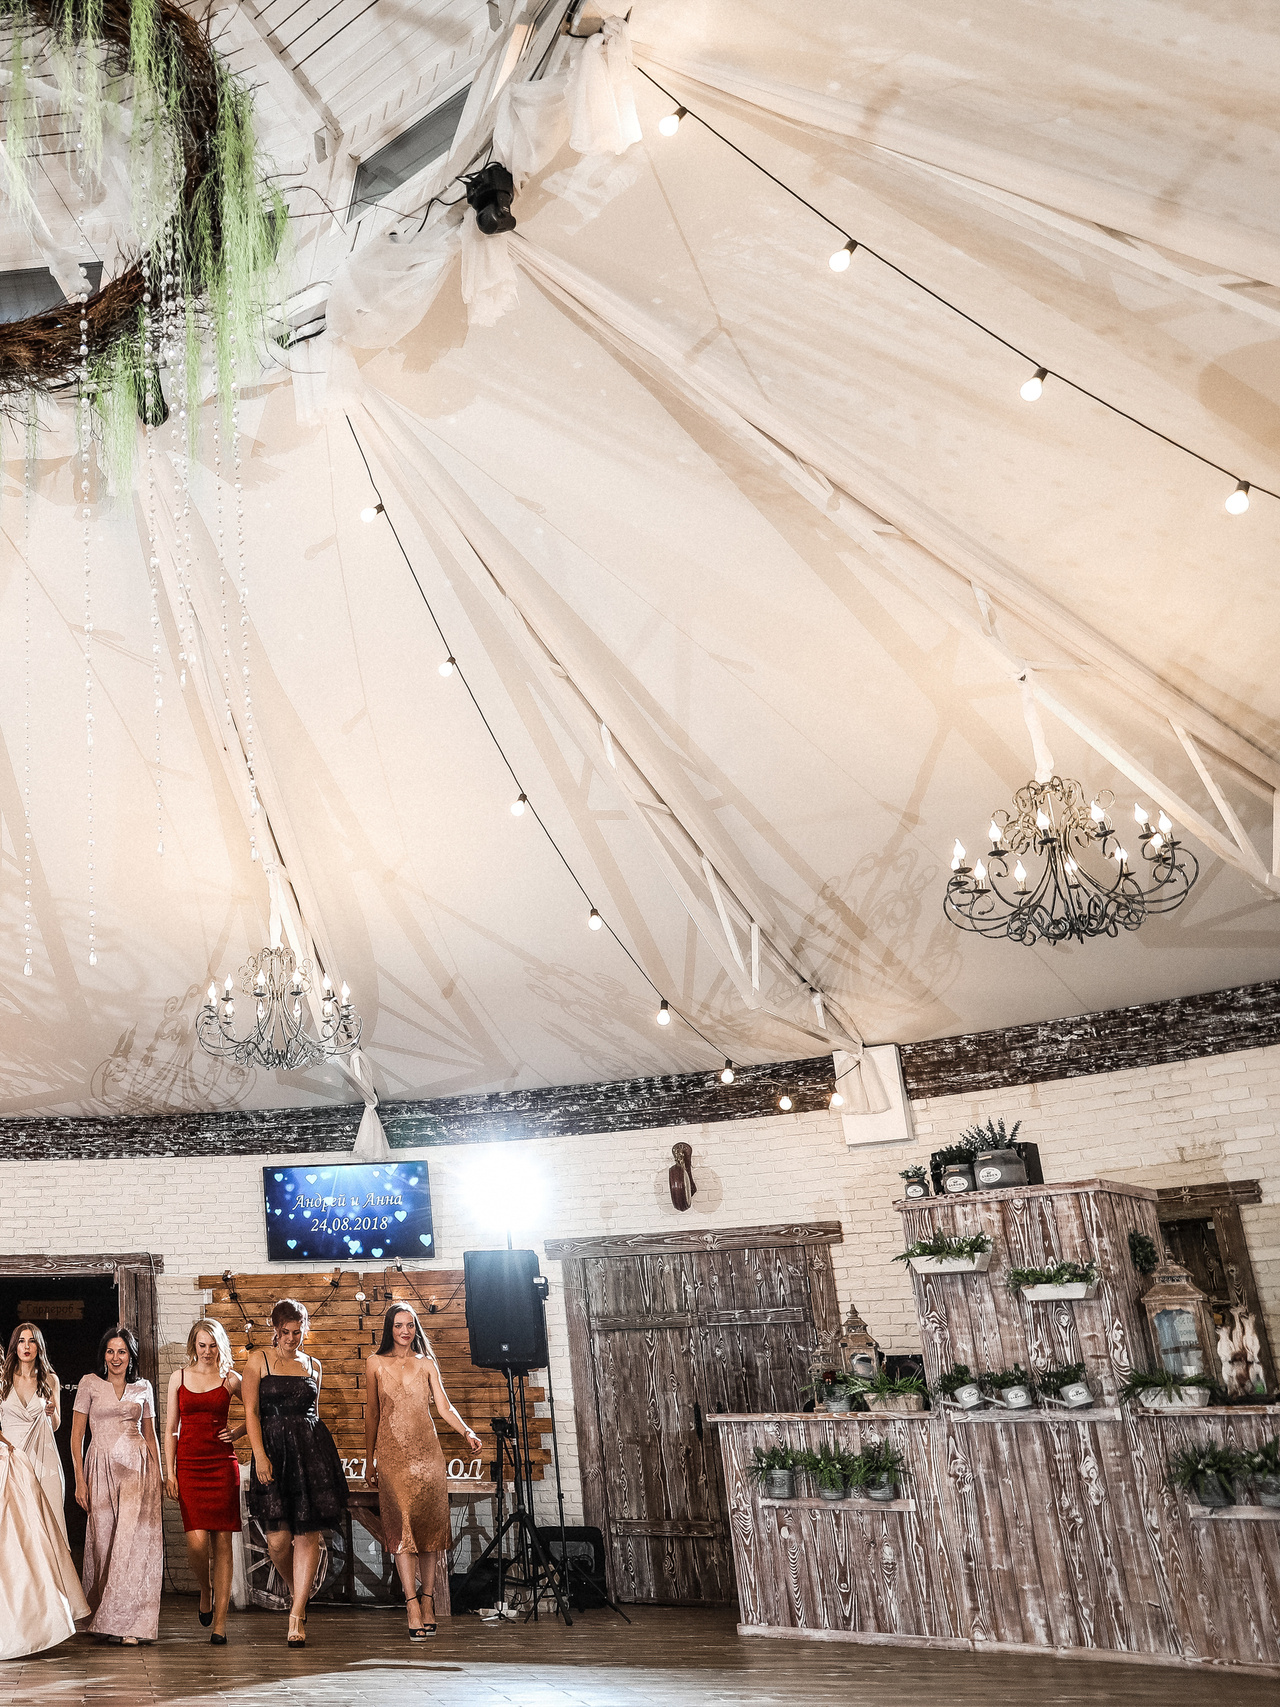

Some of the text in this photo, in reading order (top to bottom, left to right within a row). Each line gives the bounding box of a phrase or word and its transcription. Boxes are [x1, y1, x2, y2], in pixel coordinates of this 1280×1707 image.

[292, 1192, 403, 1212] Андрей и Анна
[310, 1216, 389, 1232] 24.08.2018
[26, 1303, 74, 1316] Гардероб
[446, 1458, 485, 1479] ол
